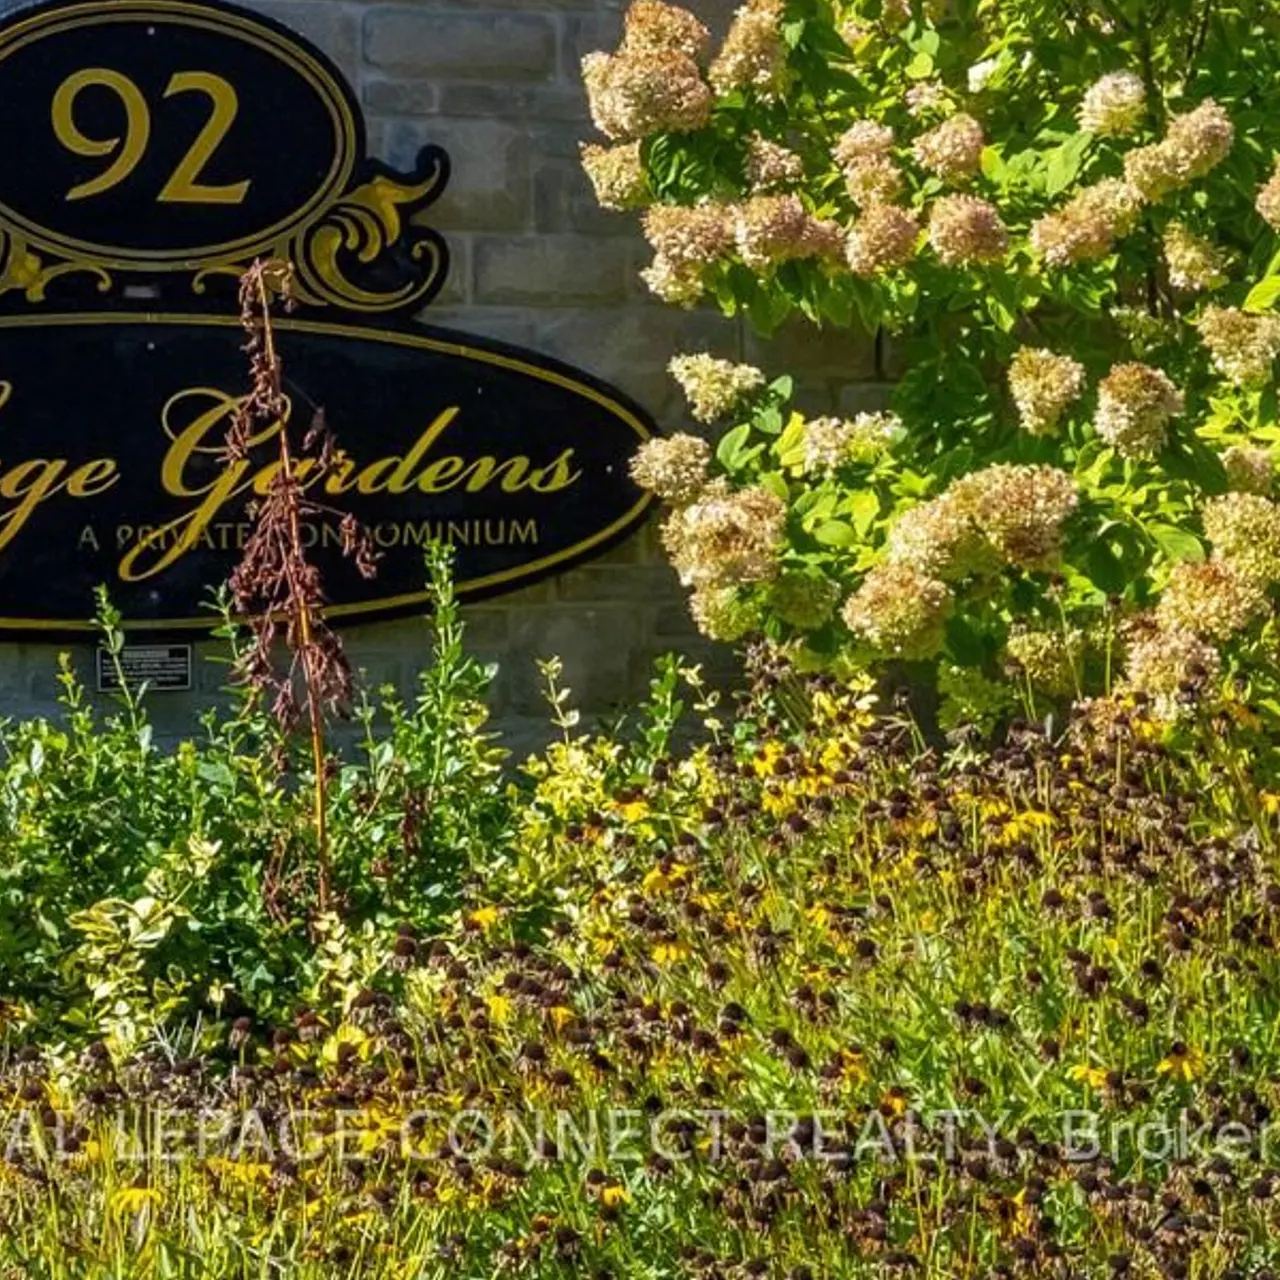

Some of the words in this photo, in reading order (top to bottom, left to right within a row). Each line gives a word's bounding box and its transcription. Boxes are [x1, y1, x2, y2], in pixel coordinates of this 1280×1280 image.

[51, 68, 251, 204] 92
[78, 525, 101, 552] A
[266, 519, 539, 549] ONOMINIUM
[119, 387, 582, 582] Gardens
